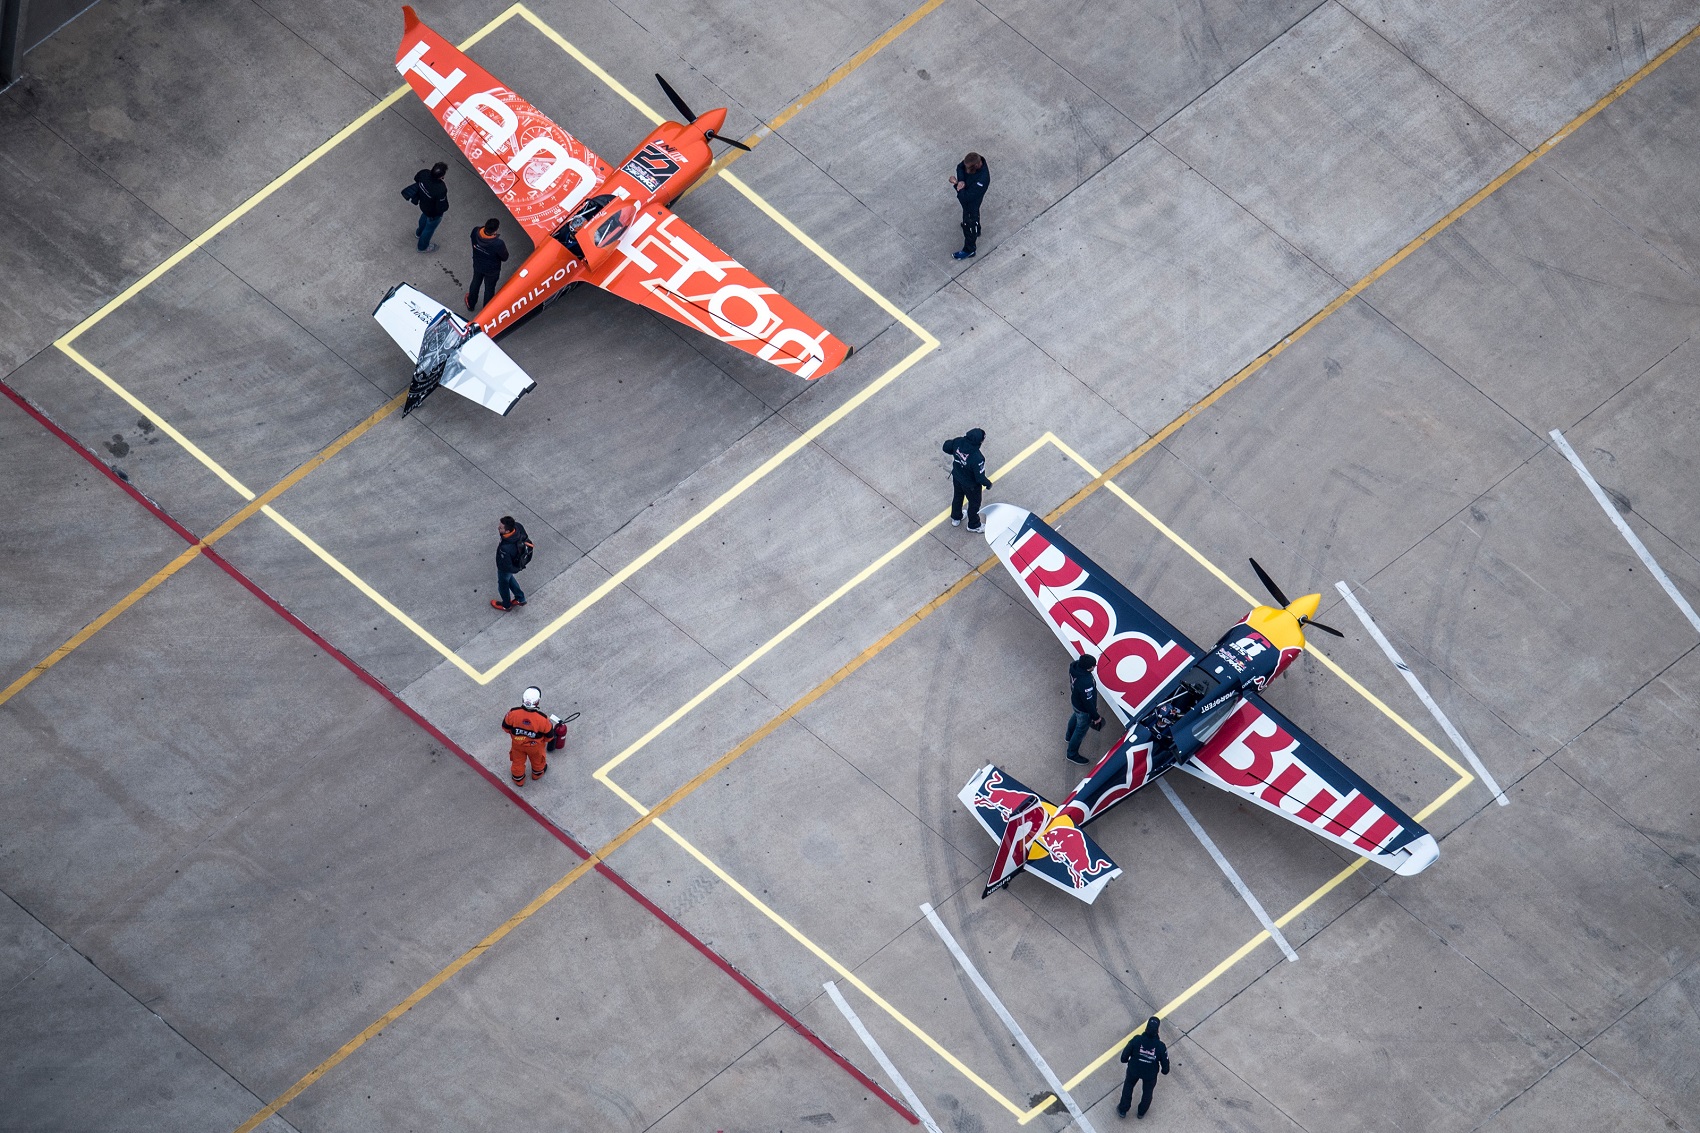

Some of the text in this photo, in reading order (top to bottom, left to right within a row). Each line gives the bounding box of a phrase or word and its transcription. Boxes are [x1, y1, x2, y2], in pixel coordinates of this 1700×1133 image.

[482, 260, 579, 333] HAMILTON
[1010, 529, 1195, 708] Red
[515, 728, 536, 738] TEXAS
[1201, 689, 1236, 714] AGROFERT
[1195, 696, 1402, 856] Bull
